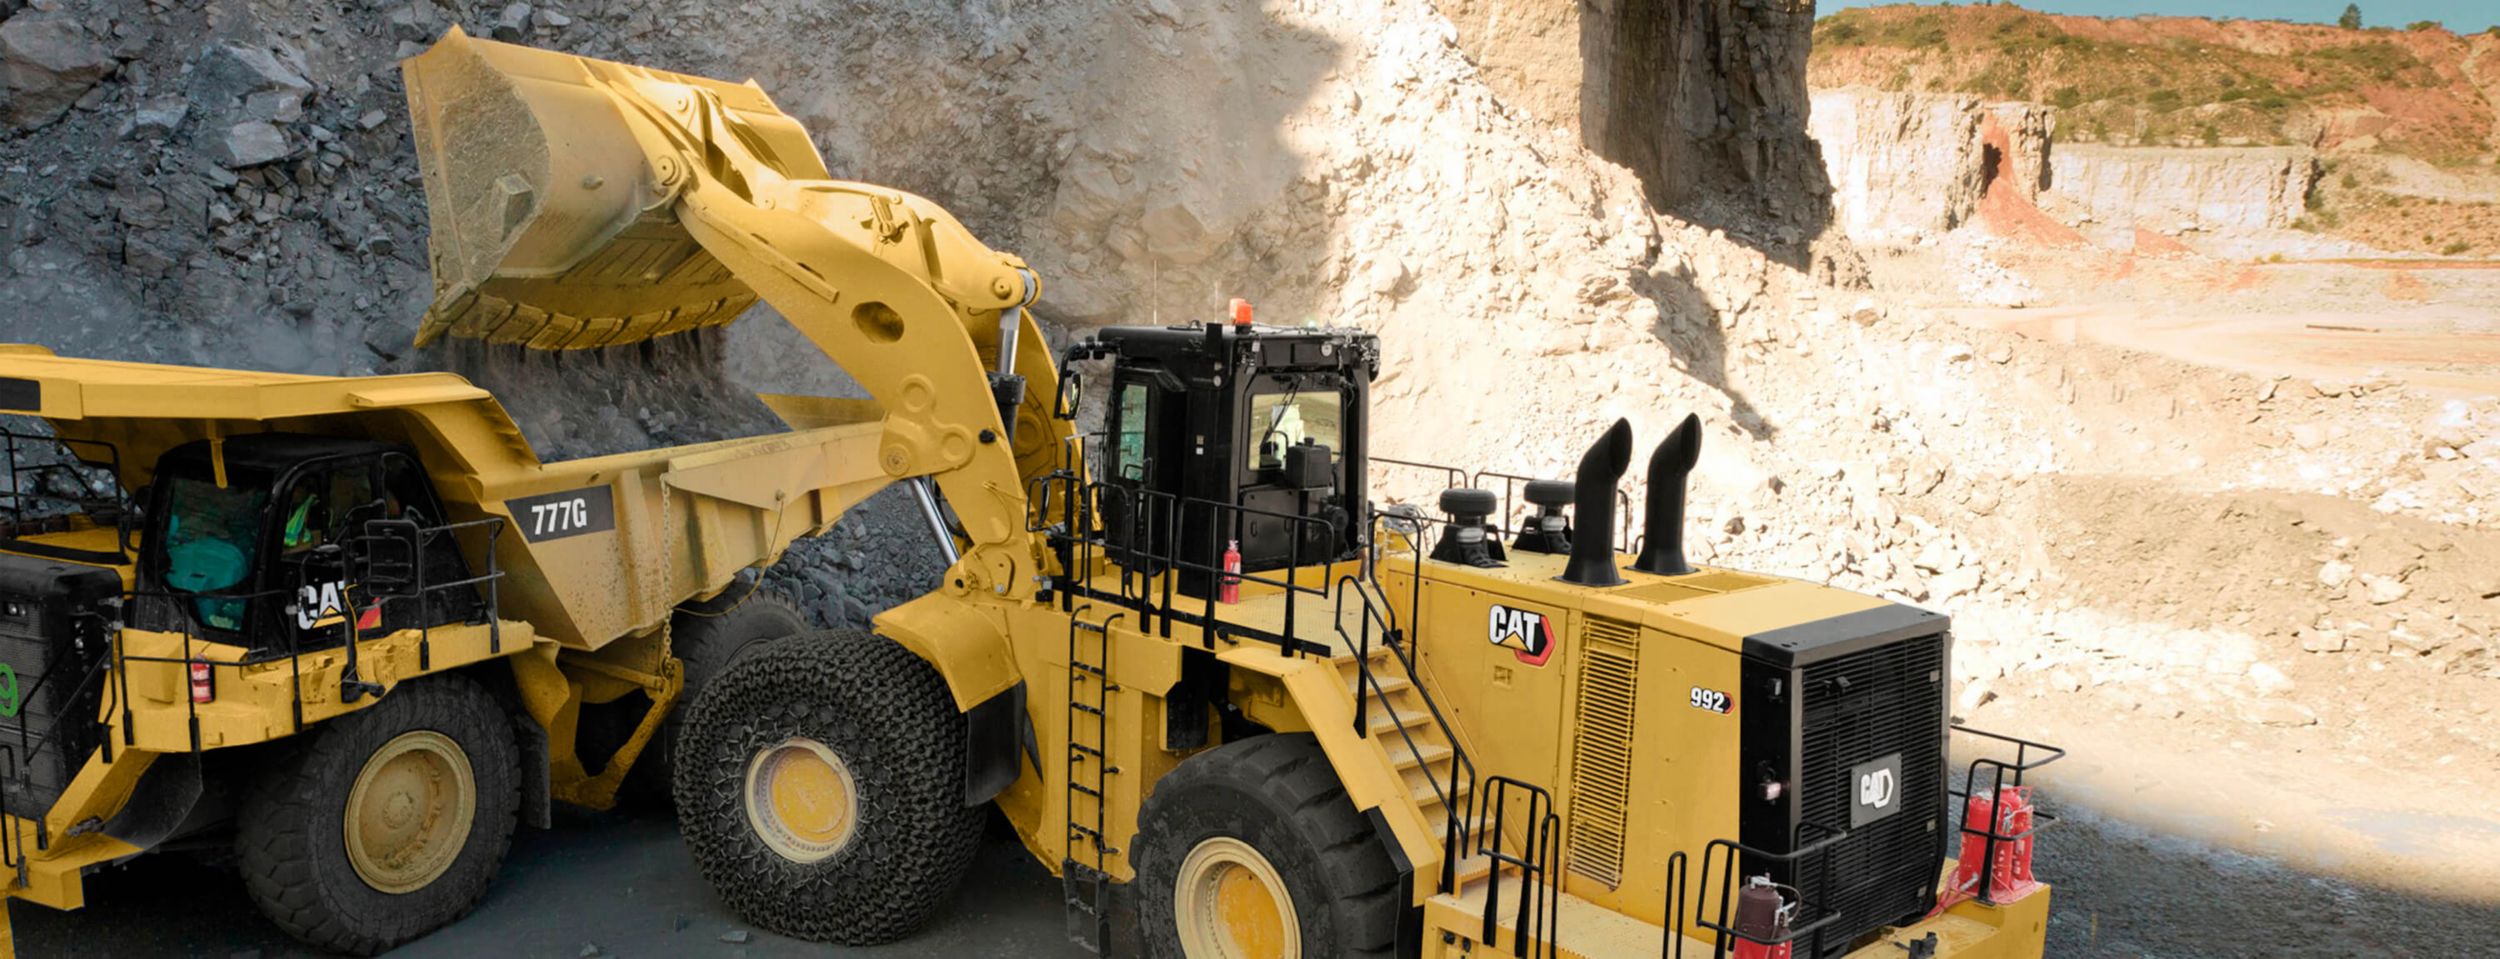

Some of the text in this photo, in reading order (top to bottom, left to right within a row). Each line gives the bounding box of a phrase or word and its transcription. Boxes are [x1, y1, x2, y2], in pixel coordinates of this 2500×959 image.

[531, 498, 587, 535] 777G
[298, 580, 357, 630] CA
[1488, 604, 1541, 653] CAT
[1690, 687, 1725, 713] 992
[1861, 768, 1891, 806] CAT
